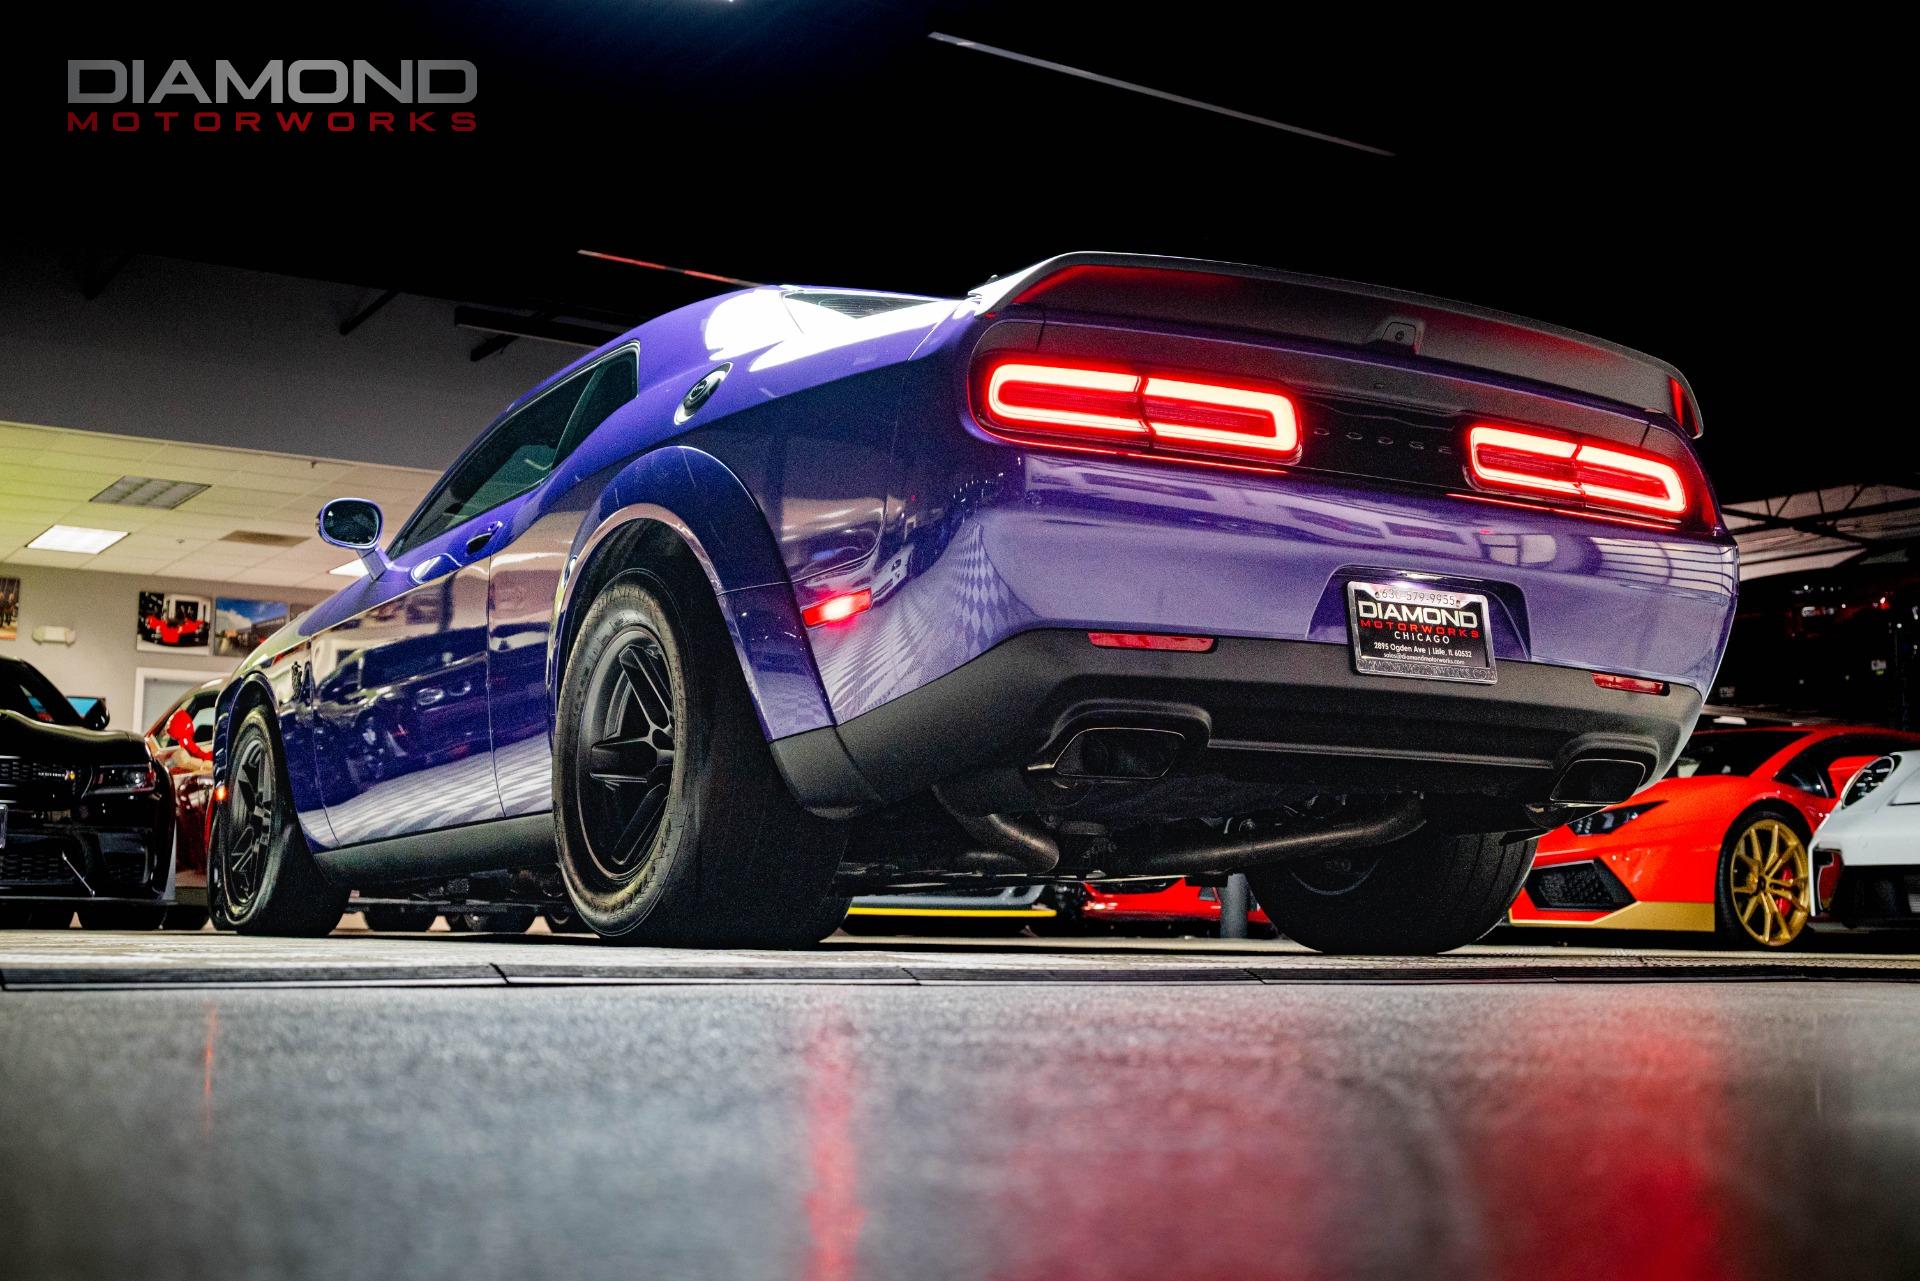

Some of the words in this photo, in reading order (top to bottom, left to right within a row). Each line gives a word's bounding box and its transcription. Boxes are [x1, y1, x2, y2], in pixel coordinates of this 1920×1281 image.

[1312, 427, 1453, 455] DODGE
[1357, 600, 1478, 628] DIAMOND
[1360, 619, 1479, 638] MOTORWORKS
[1394, 630, 1450, 644] CHICAGO
[1373, 641, 1389, 651] 2895
[1390, 643, 1412, 653] Ogden
[1413, 646, 1426, 654] Ave
